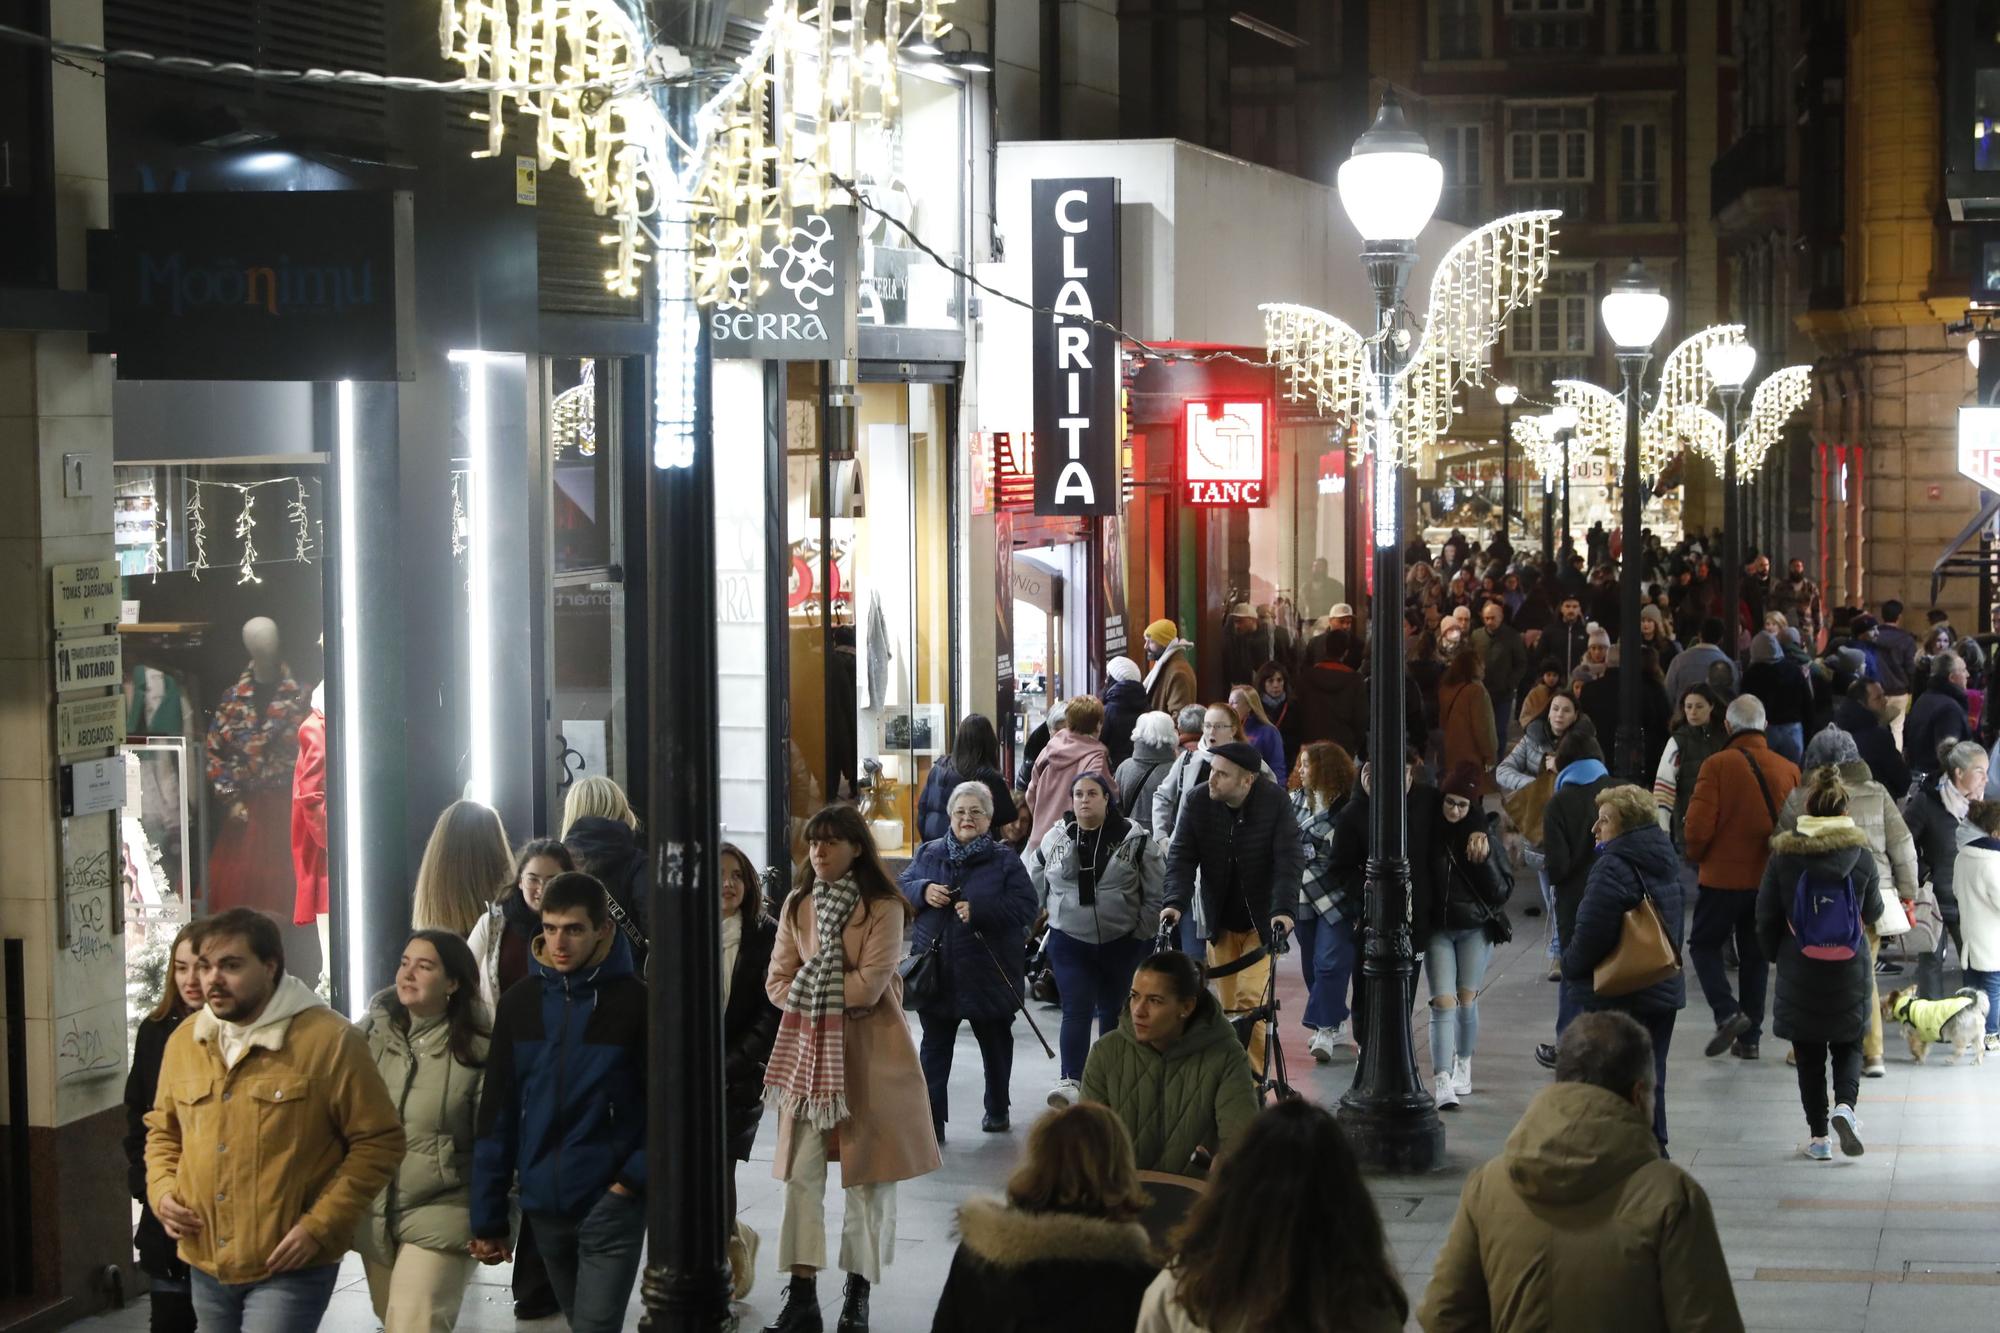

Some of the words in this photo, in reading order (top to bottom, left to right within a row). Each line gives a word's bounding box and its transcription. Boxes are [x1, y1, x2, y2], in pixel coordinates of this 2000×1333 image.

[1054, 189, 1095, 504] CLARITA
[1189, 481, 1260, 503] TANC
[76, 660, 114, 680] NOTARIO
[78, 725, 114, 747] ABOGADOS
